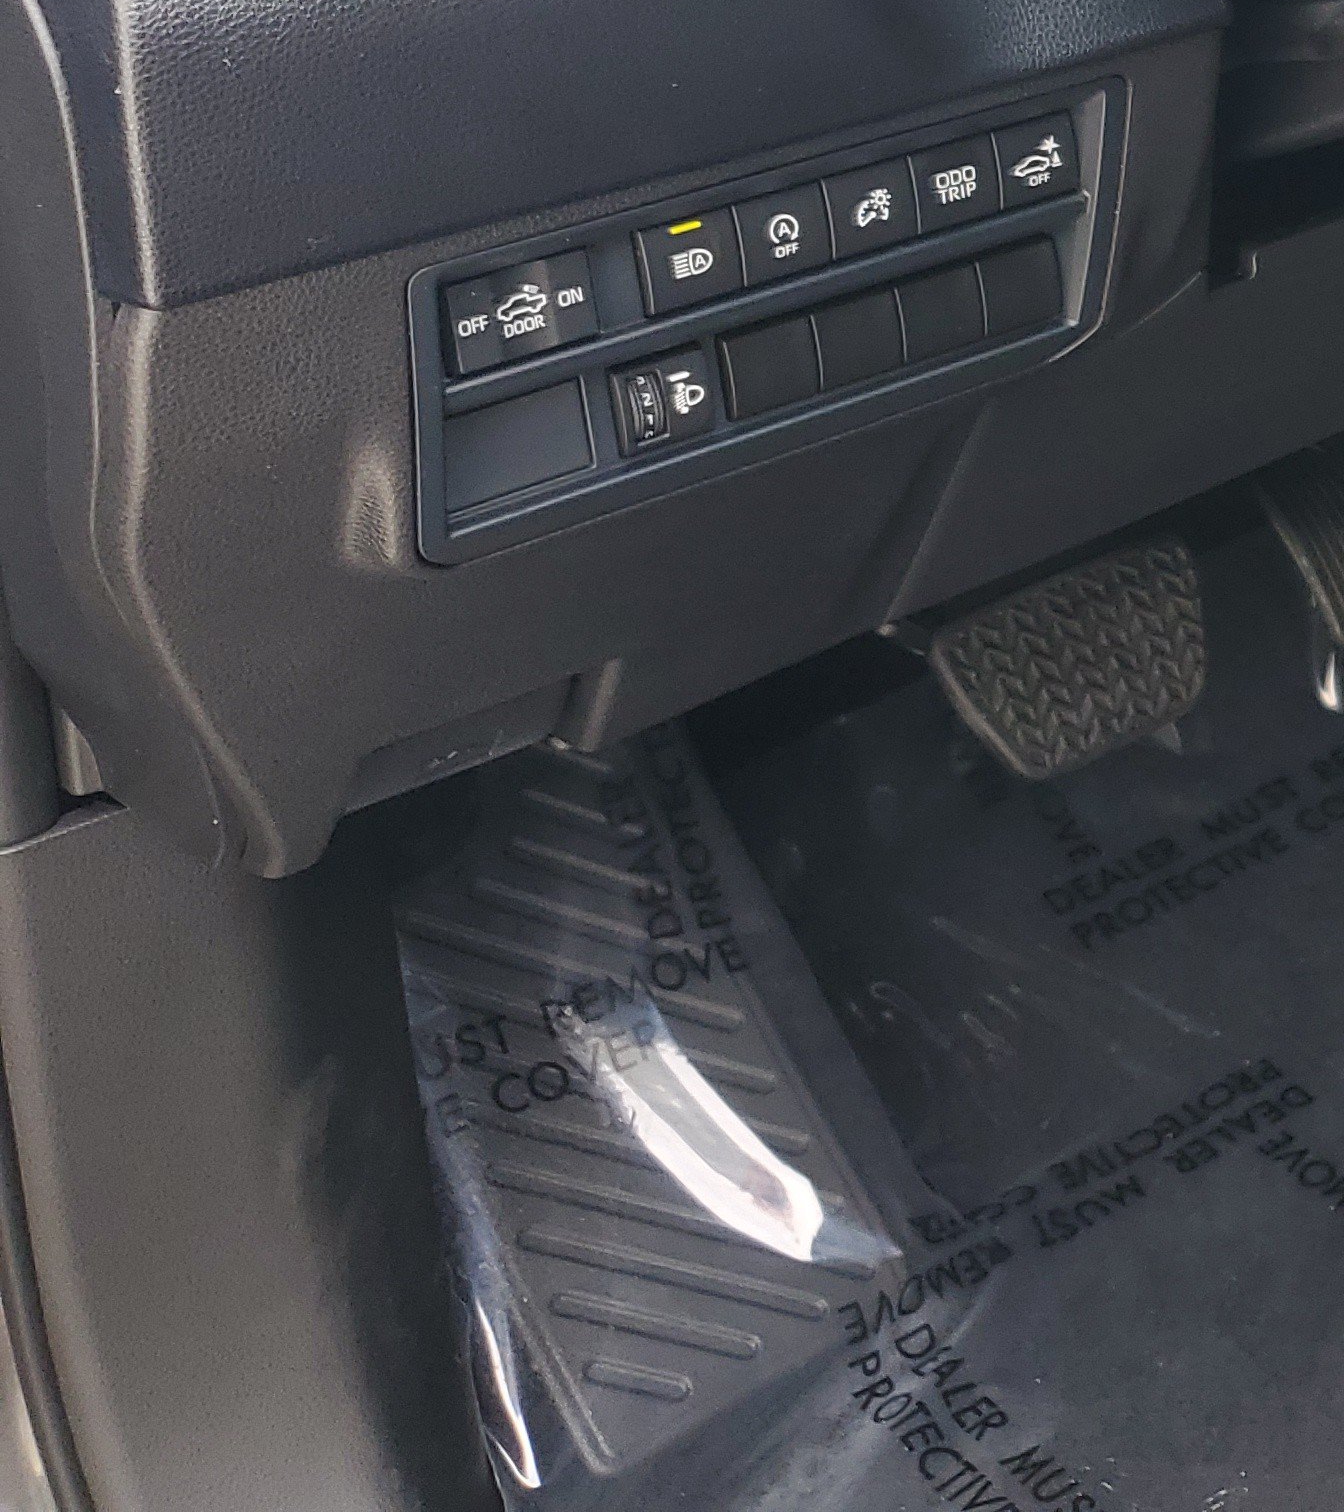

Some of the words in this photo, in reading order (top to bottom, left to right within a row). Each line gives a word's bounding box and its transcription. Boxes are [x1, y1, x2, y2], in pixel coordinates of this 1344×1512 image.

[935, 164, 976, 190] ODO
[1028, 171, 1052, 187] OFF
[938, 181, 977, 205] TRIP
[774, 241, 801, 259] OFF
[557, 286, 585, 309] ON
[457, 314, 491, 338] OFF
[503, 314, 547, 339] DOOR
[1069, 825, 1292, 950] PROTECTIVE
[420, 1014, 513, 1082] UST
[540, 934, 750, 1040] REMOVE
[1047, 1056, 1284, 1192] PROTECTIVE
[1164, 1083, 1316, 1175] DEALER
[1031, 1174, 1148, 1249] MUST
[838, 1235, 1014, 1346] REMOVE
